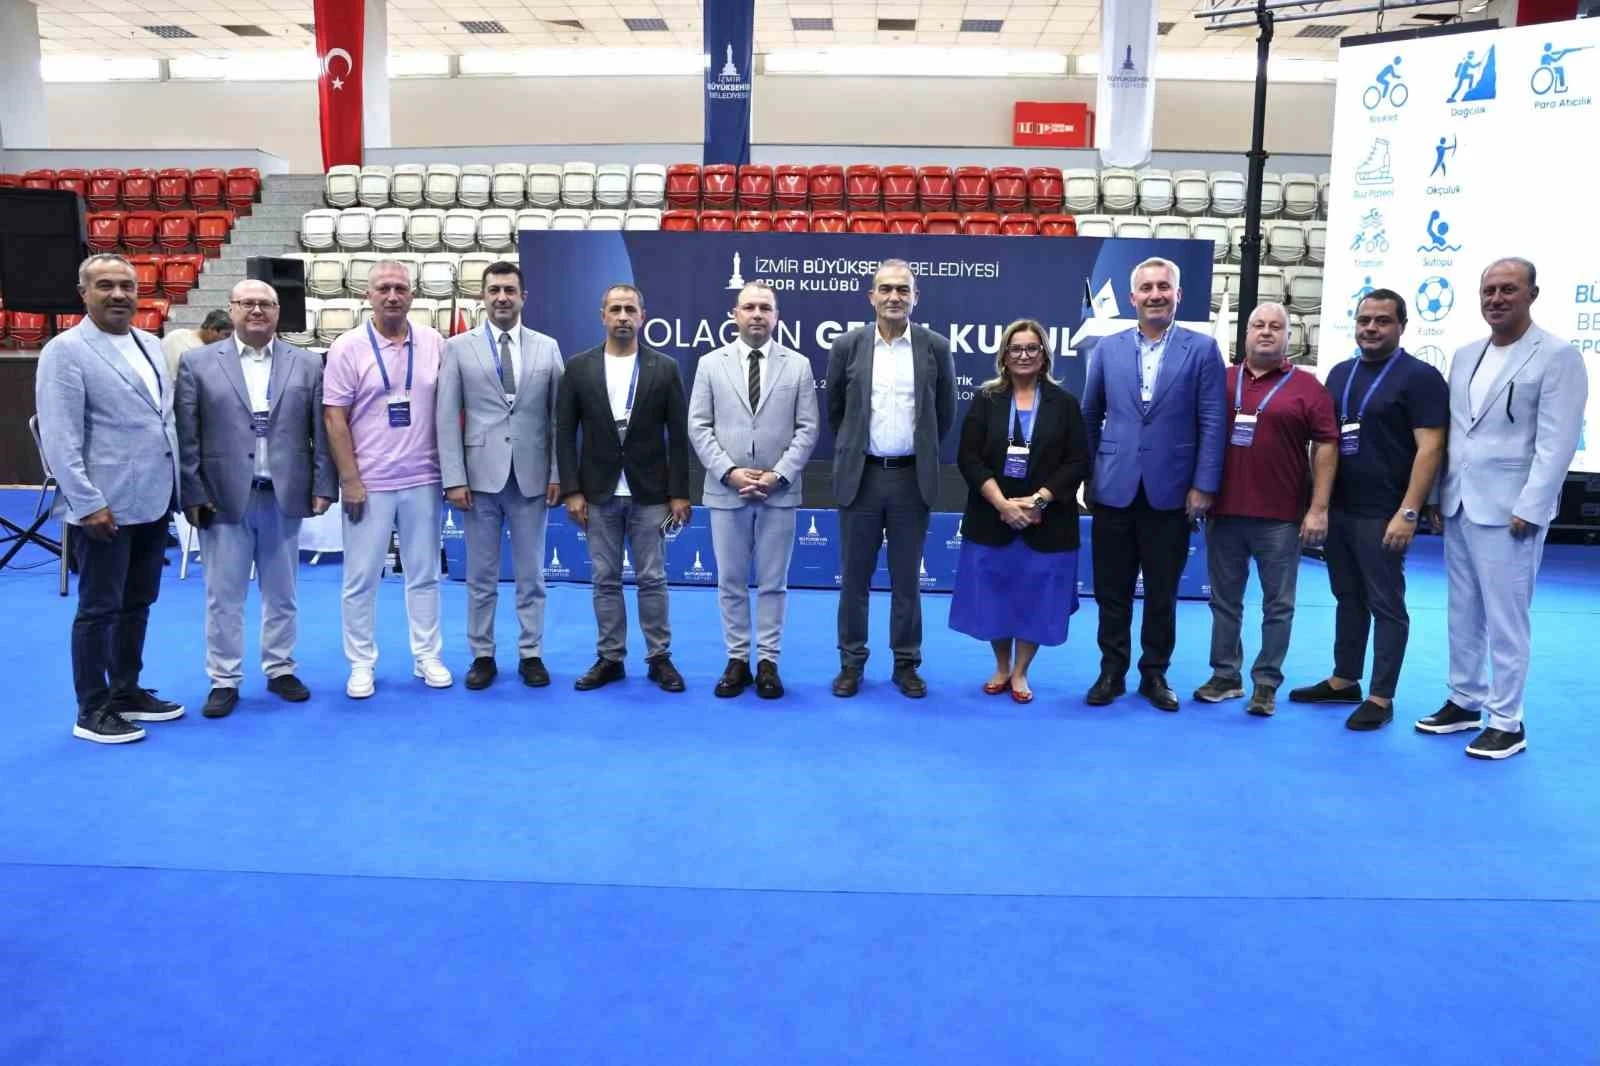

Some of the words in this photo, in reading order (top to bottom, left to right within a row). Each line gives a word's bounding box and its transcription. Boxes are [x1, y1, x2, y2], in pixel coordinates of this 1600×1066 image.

[755, 255, 799, 273] İZMİR
[908, 260, 1000, 278] BELEDİYESİ
[800, 278, 860, 292] KULÜBÜ
[643, 311, 801, 349] OLAĞN
